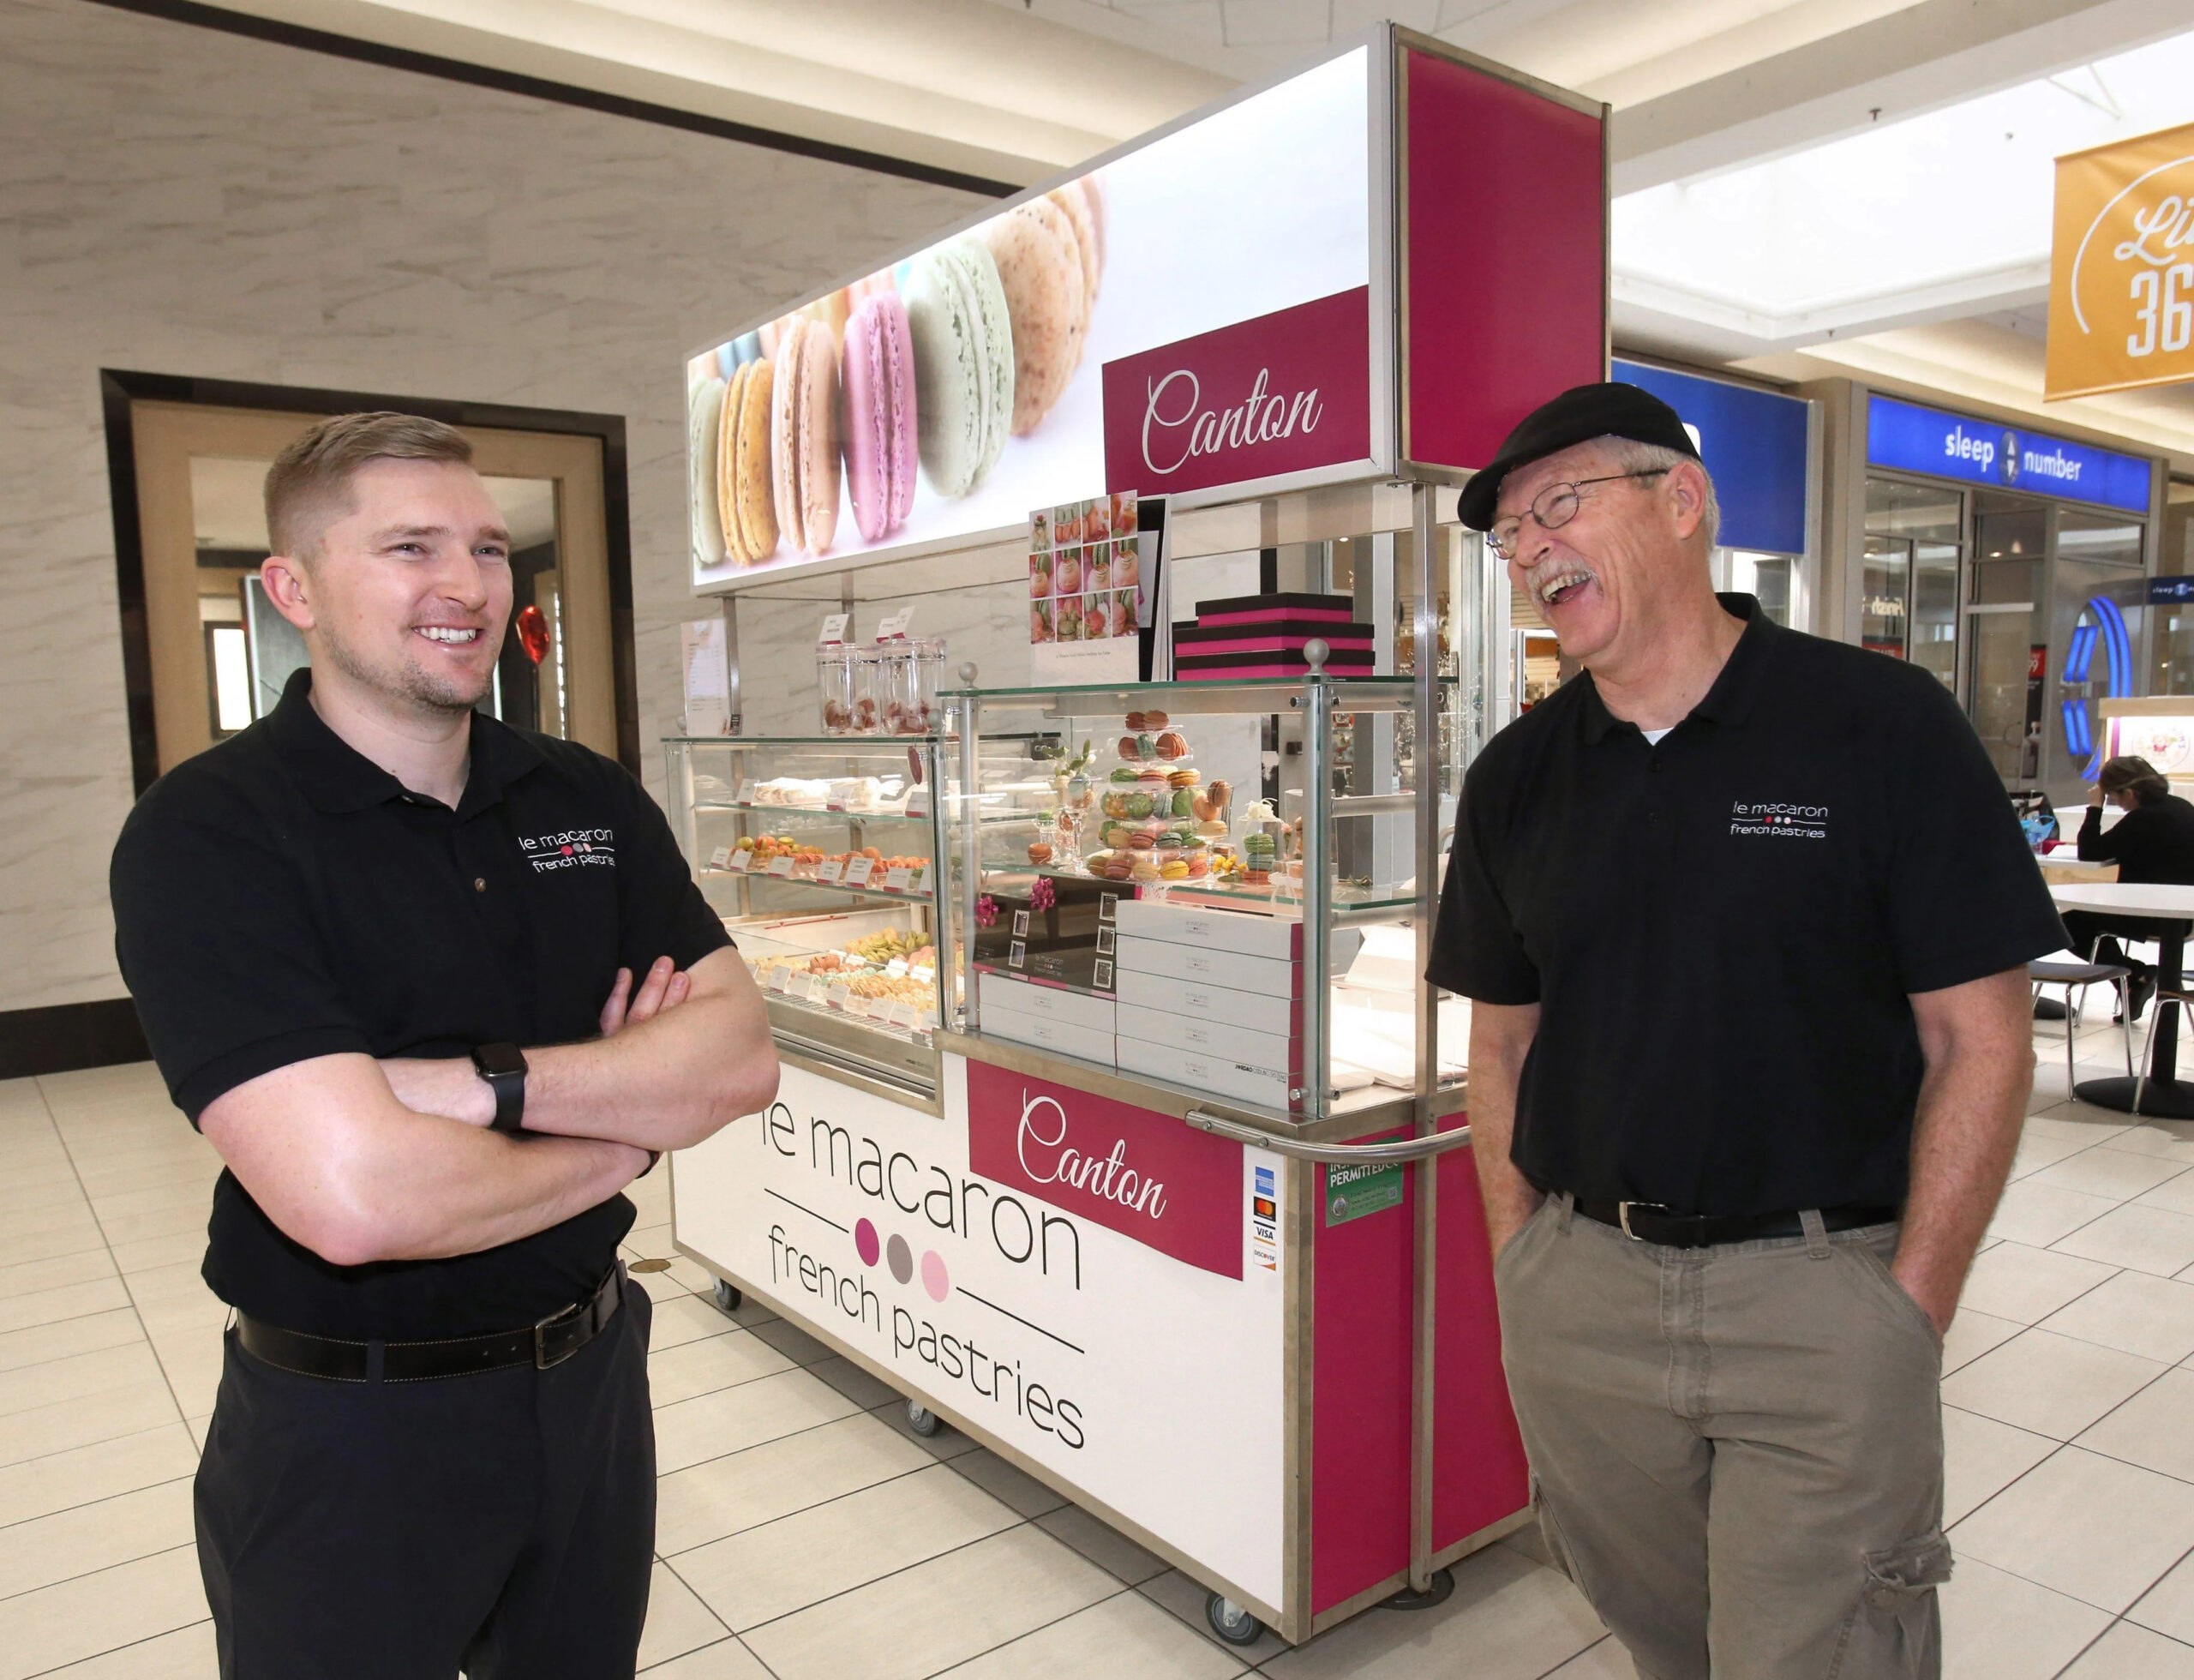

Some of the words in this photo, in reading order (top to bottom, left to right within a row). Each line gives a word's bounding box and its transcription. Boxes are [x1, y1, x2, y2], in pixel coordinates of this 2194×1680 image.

[2113, 195, 2194, 266] Li
[1142, 367, 1323, 474] Canton
[1945, 424, 1994, 473] sleep
[2023, 448, 2082, 482] number
[1733, 801, 1748, 813] le
[1751, 803, 1828, 817] macaron
[518, 837, 538, 851] le
[539, 829, 613, 848] macaron
[1730, 824, 1770, 835] french
[1771, 826, 1825, 838] pastries
[532, 856, 578, 873] french
[1017, 1087, 1167, 1219] Canton
[1330, 1164, 1385, 1188] PERMITTED
[811, 1116, 1080, 1291] macaron
[1256, 1227, 1274, 1240] VISA
[1254, 1249, 1275, 1262] DISCOVER
[768, 1224, 881, 1332] french
[893, 1305, 1085, 1449] pastries
